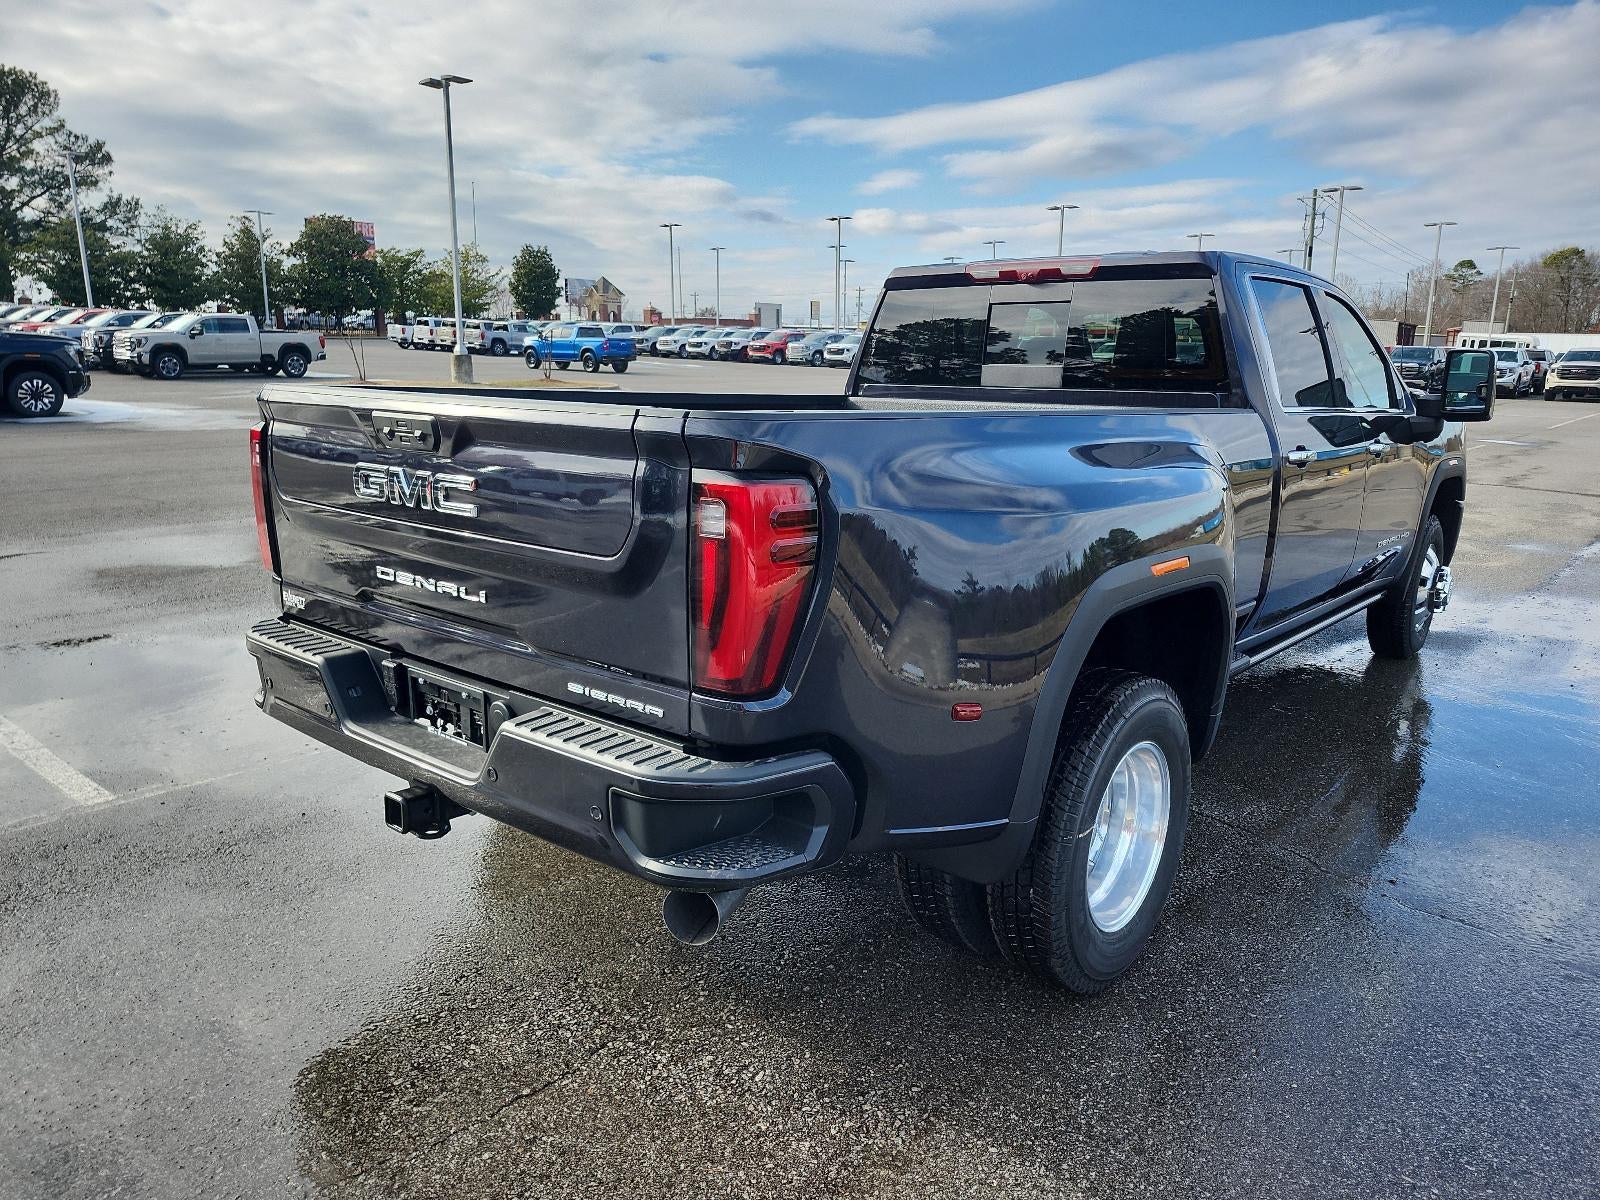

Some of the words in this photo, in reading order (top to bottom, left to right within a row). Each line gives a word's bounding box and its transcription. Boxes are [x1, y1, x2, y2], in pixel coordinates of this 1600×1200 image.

[353, 461, 479, 518] GMC
[376, 565, 486, 604] DENALI
[567, 682, 664, 718] SIERRA
